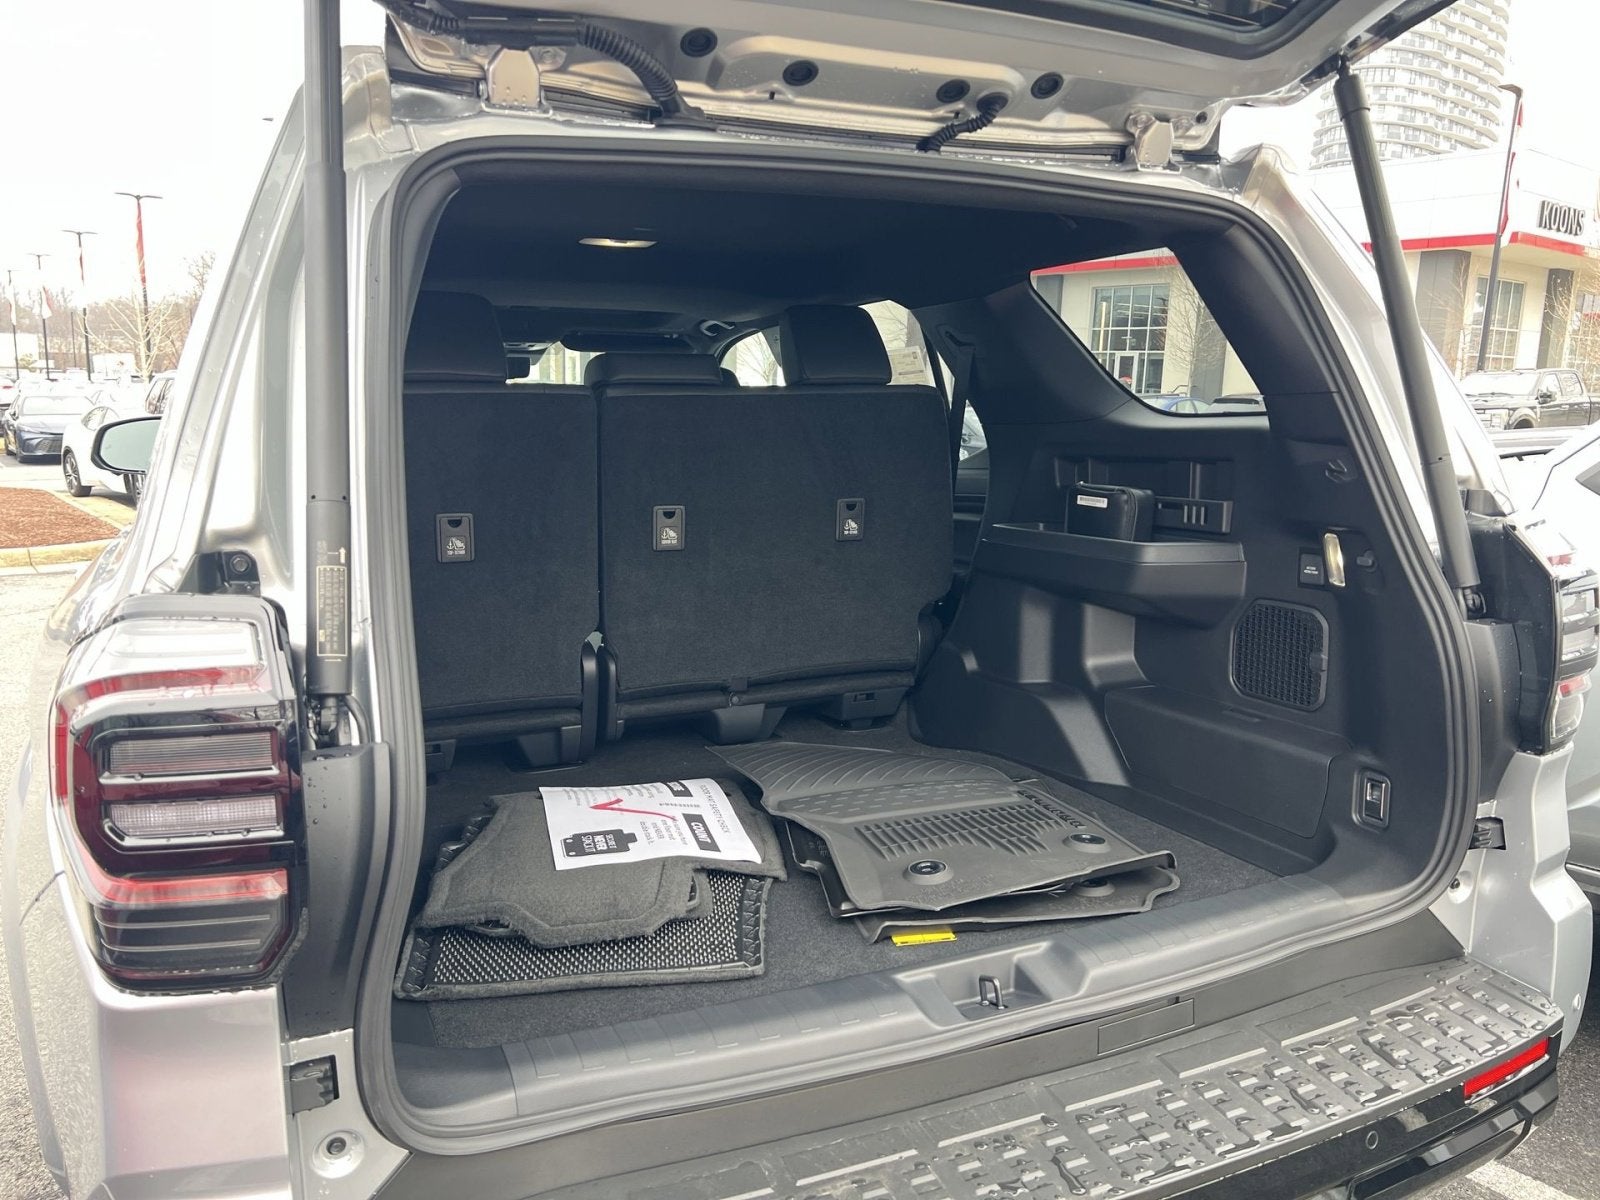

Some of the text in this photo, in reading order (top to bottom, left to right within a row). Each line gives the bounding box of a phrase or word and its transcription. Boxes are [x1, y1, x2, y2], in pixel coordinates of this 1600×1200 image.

[1538, 201, 1585, 236] KOONS
[709, 803, 722, 818] SAFETY
[717, 819, 730, 833] CHECK
[593, 834, 608, 850] NEVER
[690, 821, 712, 843] COUNT
